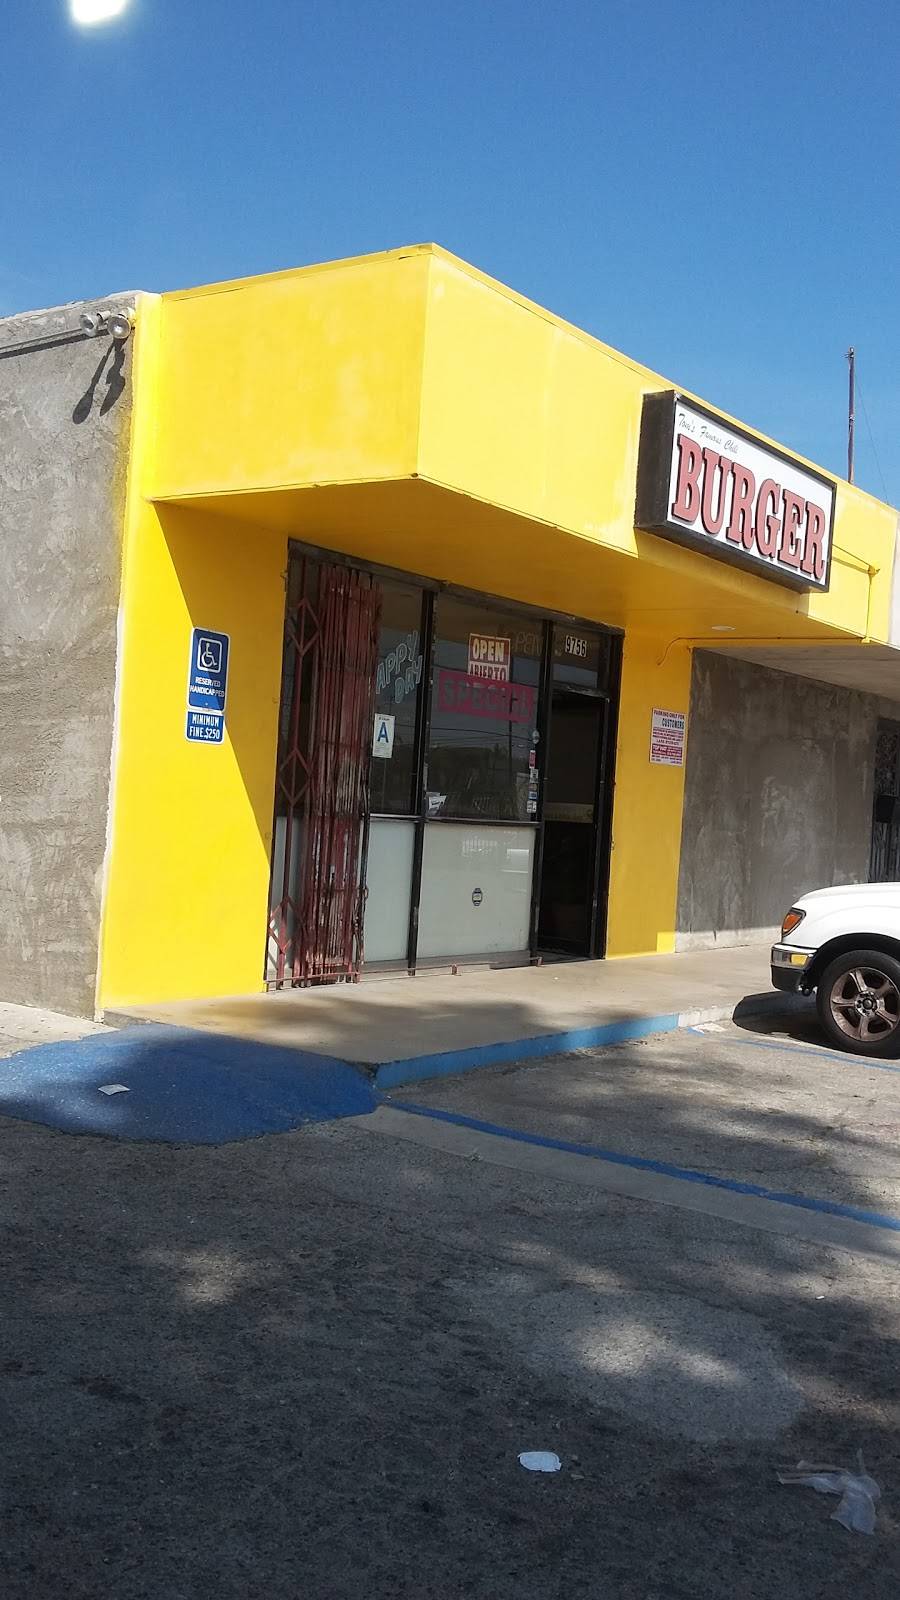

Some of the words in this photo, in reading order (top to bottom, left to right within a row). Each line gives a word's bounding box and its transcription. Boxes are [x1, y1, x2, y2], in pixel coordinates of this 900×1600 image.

[671, 433, 826, 580] BURGER
[472, 638, 505, 663] OPEN
[565, 635, 587, 657] 9756
[376, 630, 418, 695] APPY
[195, 677, 220, 688] RESERVED
[394, 654, 423, 704] DAY
[469, 665, 507, 682] ABIERTO
[190, 685, 224, 697] HANDICAPPED
[192, 714, 219, 727] MINIMUM
[661, 718, 685, 730] CUSTOMERS
[189, 726, 203, 738] FINE
[204, 728, 220, 740] $250
[377, 721, 389, 743] A
